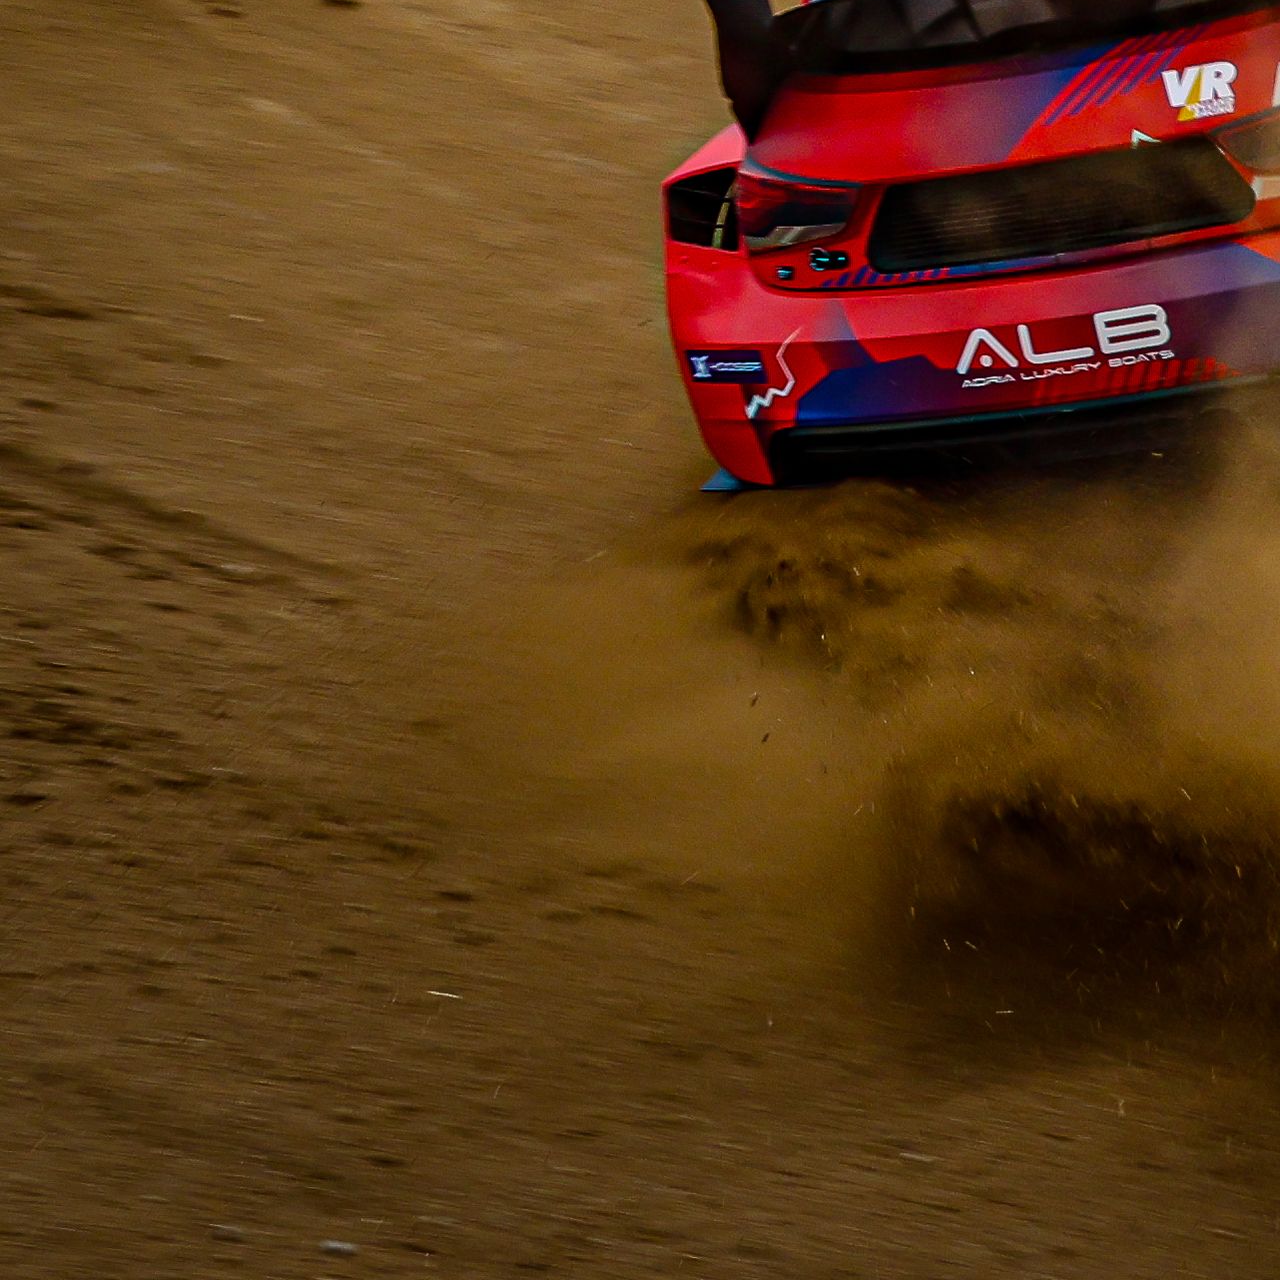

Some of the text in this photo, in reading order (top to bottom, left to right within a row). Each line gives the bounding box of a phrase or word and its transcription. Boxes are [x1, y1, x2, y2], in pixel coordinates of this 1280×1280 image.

[1161, 61, 1239, 108] VR
[956, 303, 1172, 375] ALB
[1020, 362, 1102, 382] LUXURY
[1108, 349, 1175, 368] BOATS
